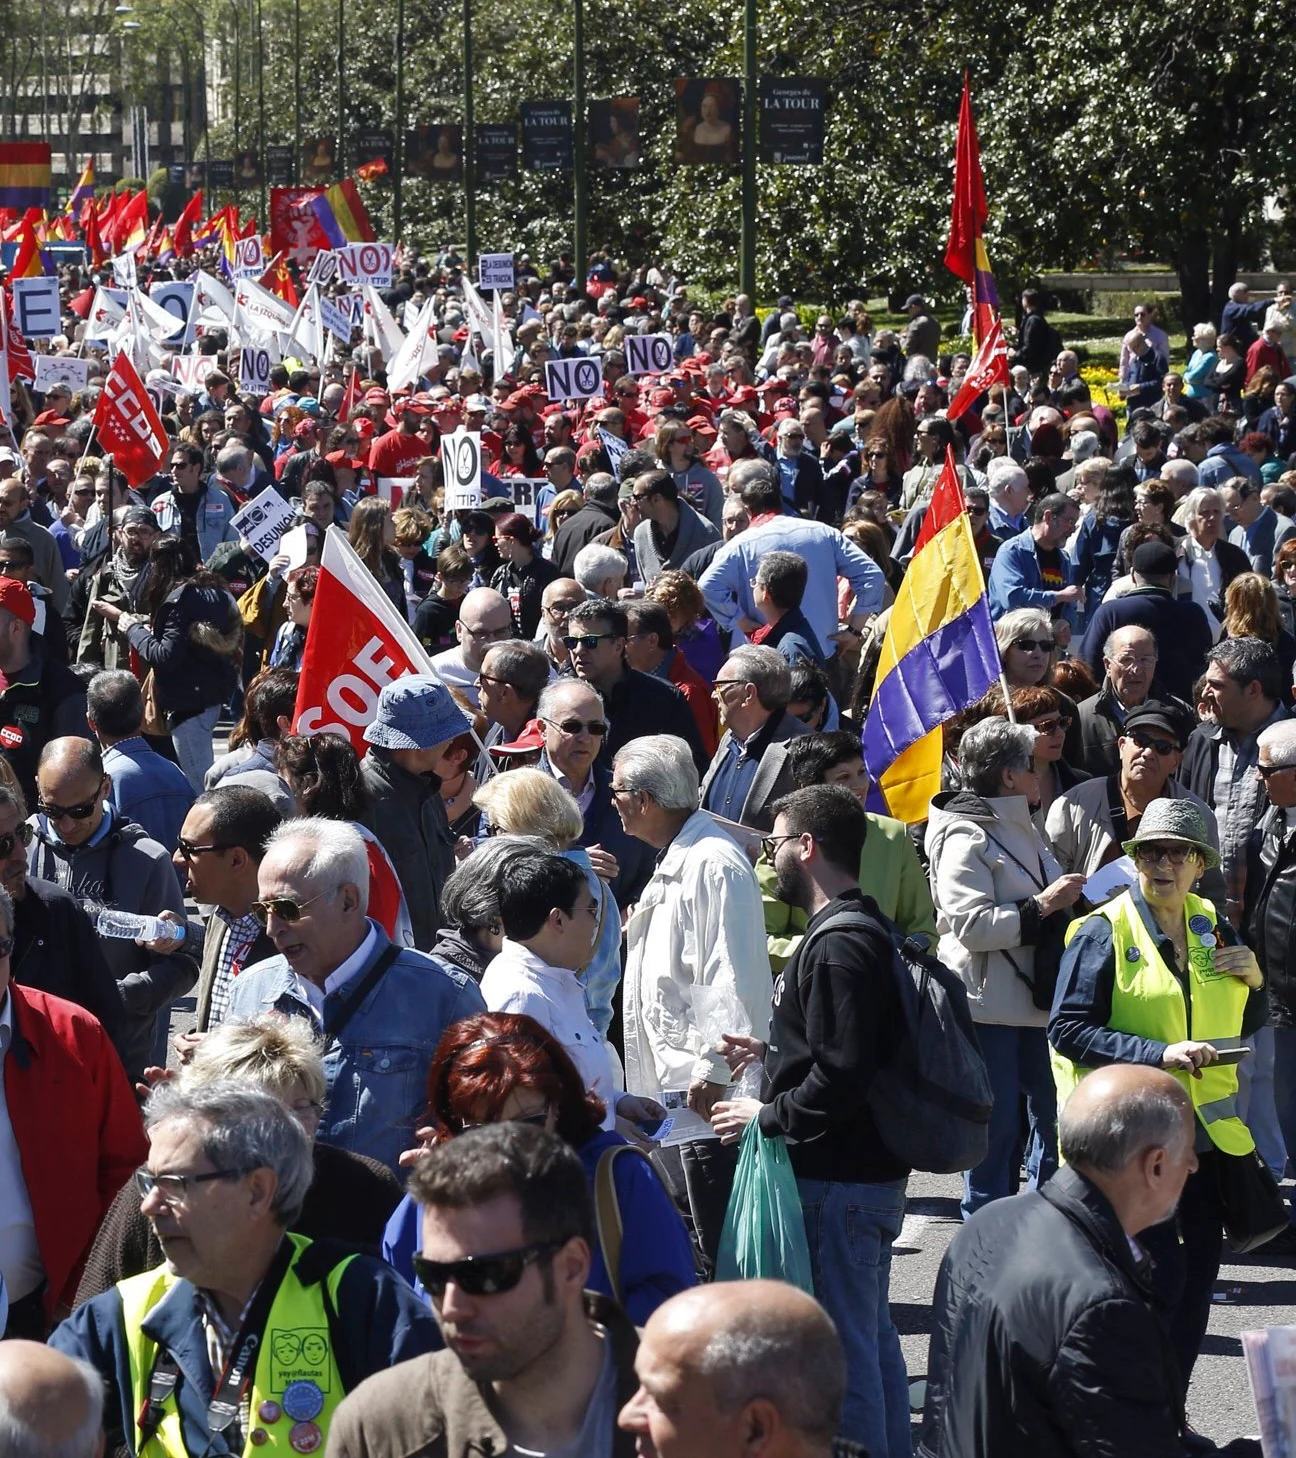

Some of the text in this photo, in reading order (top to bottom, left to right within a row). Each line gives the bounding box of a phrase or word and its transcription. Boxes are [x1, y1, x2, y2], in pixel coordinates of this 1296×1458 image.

[764, 98, 820, 109] LA TOUR
[524, 116, 568, 126] LA TOUR
[234, 238, 261, 269] NO
[311, 252, 337, 282] NO
[338, 245, 381, 278] NO
[243, 268, 264, 278] TTIP
[370, 277, 390, 285] TTIP
[241, 348, 271, 382] NO
[629, 336, 673, 371] NO
[173, 356, 214, 385] NO
[548, 360, 600, 398] NO
[104, 369, 164, 460] CCOO
[442, 435, 478, 487] NO
[252, 509, 298, 555] DESUNIÓN
[0, 728, 24, 744] CCOO
[226, 1333, 259, 1388] Canon
